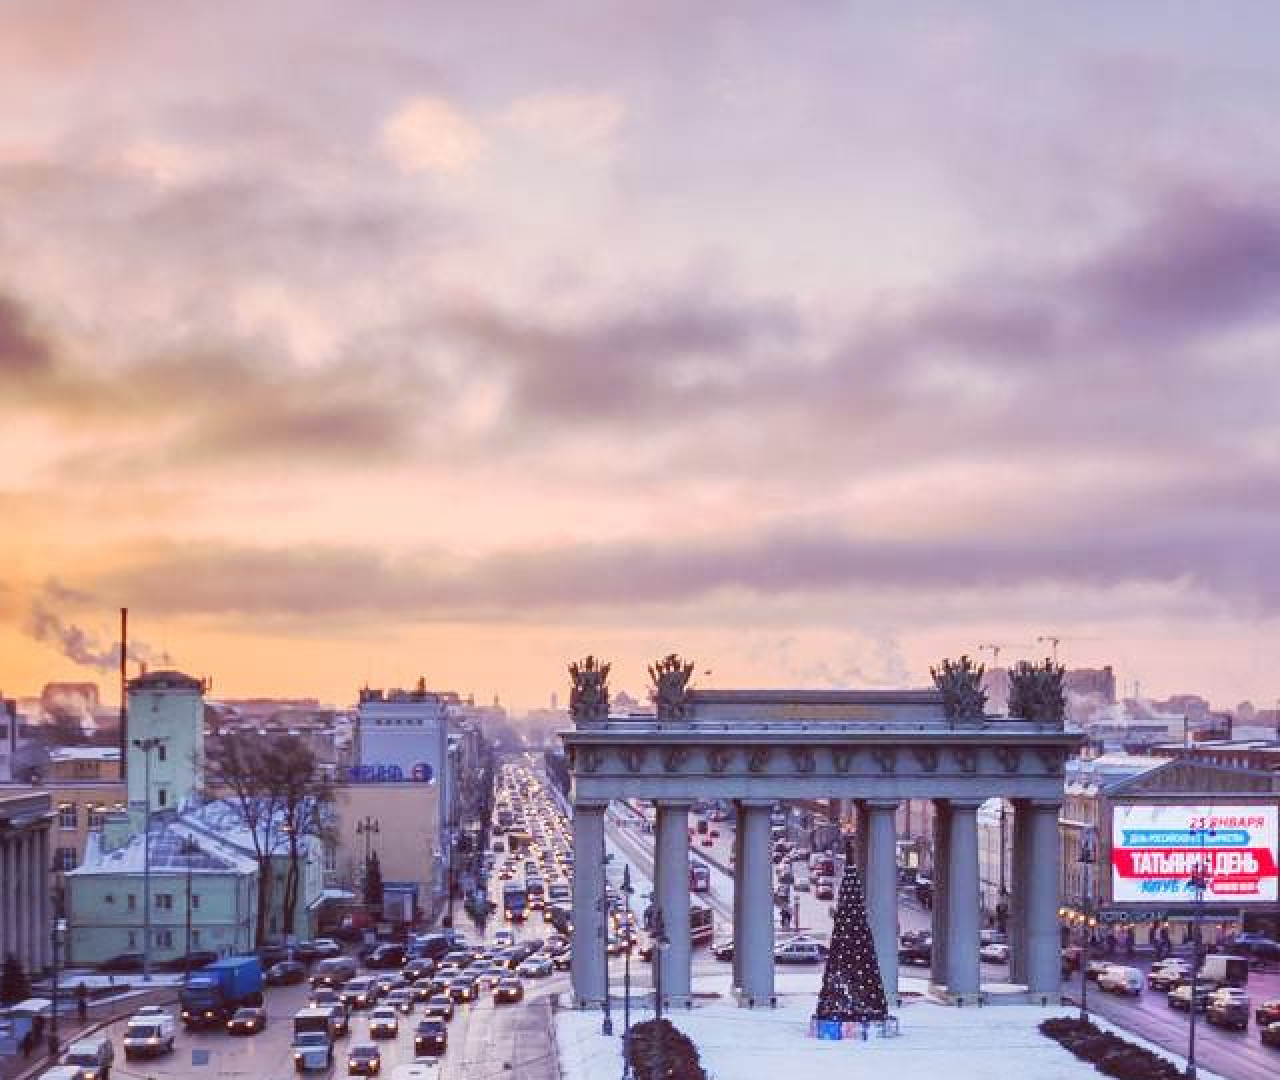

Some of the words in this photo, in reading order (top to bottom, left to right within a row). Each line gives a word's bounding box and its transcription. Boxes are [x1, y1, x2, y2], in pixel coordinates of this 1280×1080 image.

[1210, 817, 1264, 828] ЯНВАРЯ
[1131, 852, 1212, 874] ТАТЬЯНИН
[1215, 852, 1258, 875] ДЕНЬ
